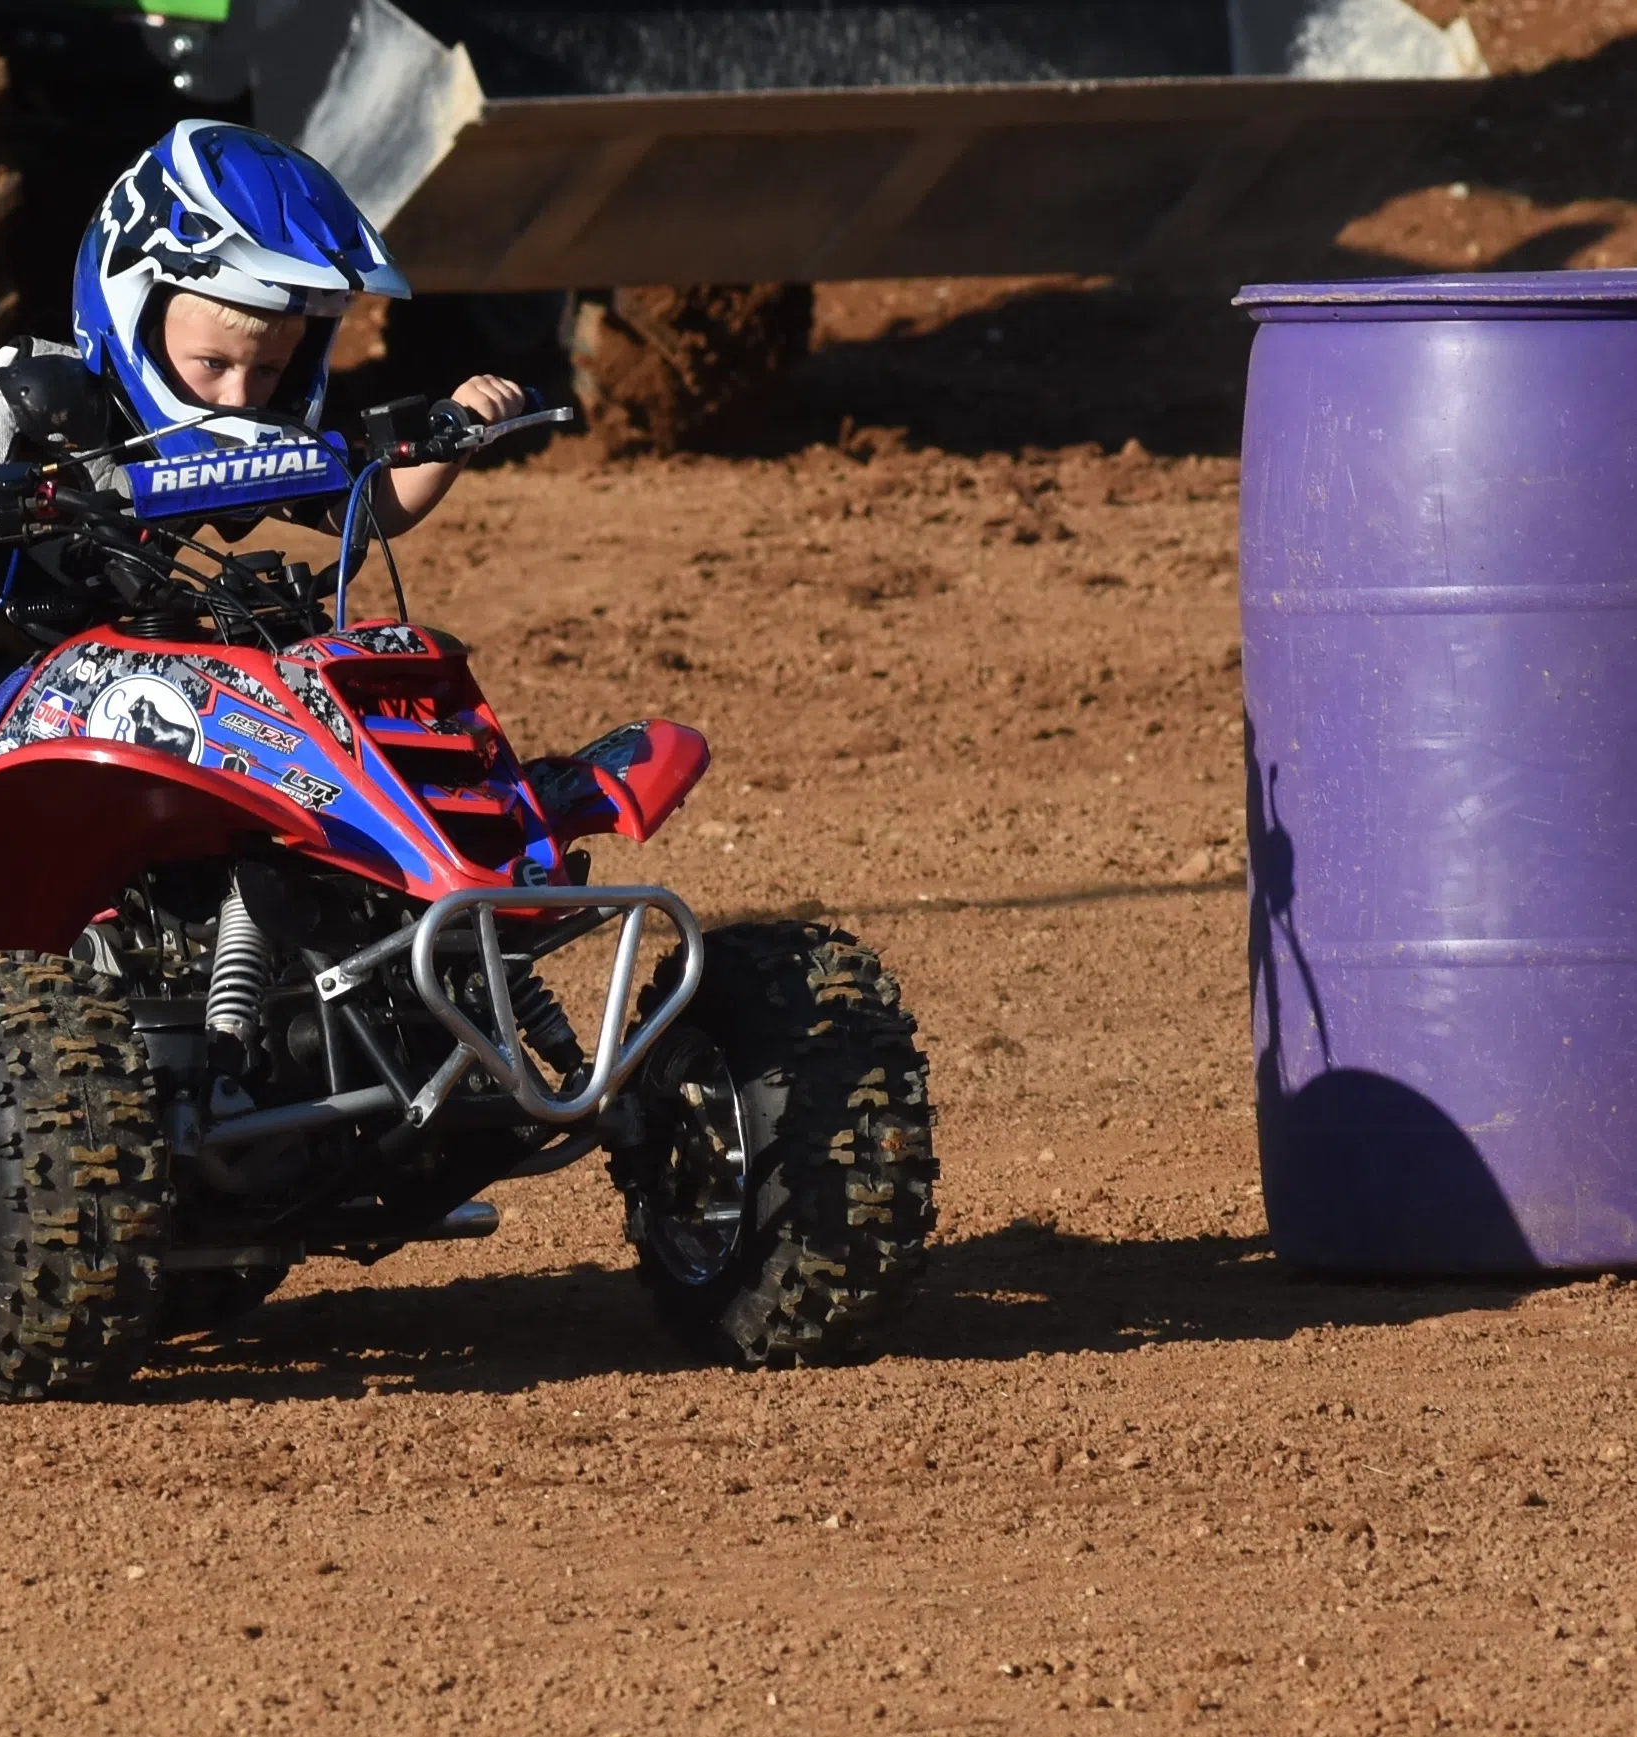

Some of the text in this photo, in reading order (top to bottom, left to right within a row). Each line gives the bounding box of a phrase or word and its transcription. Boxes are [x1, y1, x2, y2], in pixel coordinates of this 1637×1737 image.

[151, 448, 328, 493] RENTHAL
[66, 657, 107, 684] ASV
[33, 700, 69, 729] DWT
[280, 767, 342, 803] LSR
